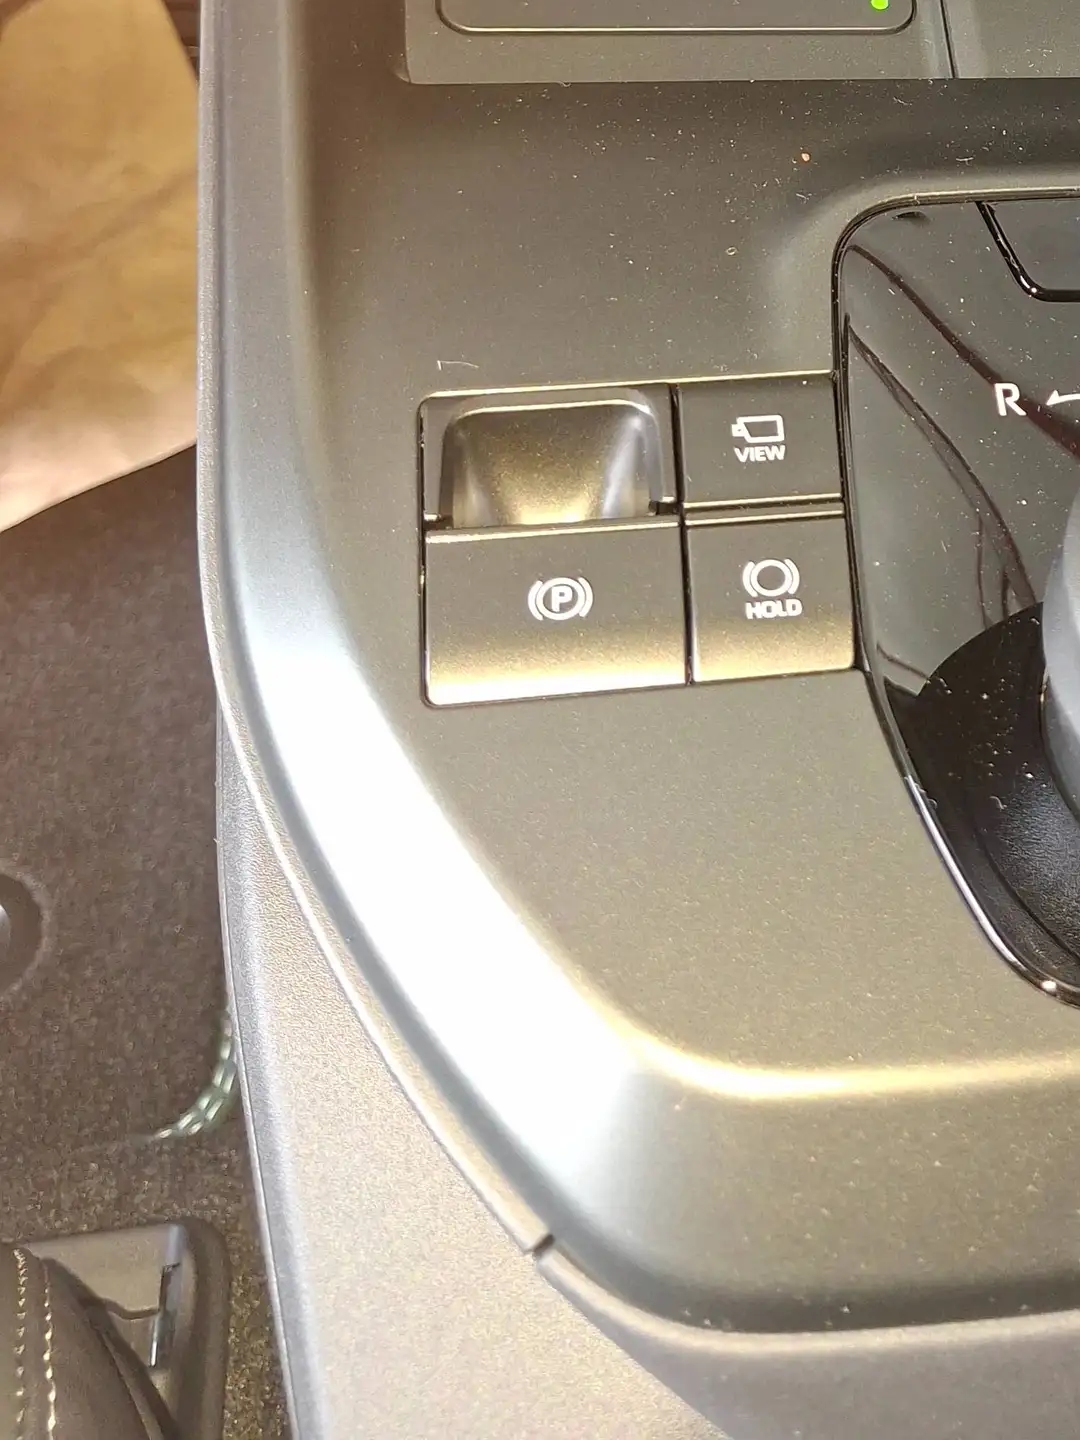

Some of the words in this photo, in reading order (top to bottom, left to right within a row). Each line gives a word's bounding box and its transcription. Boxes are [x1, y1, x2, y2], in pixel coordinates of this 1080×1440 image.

[994, 382, 1026, 417] R
[733, 445, 786, 463] VIEW
[745, 599, 802, 620] HOLD
